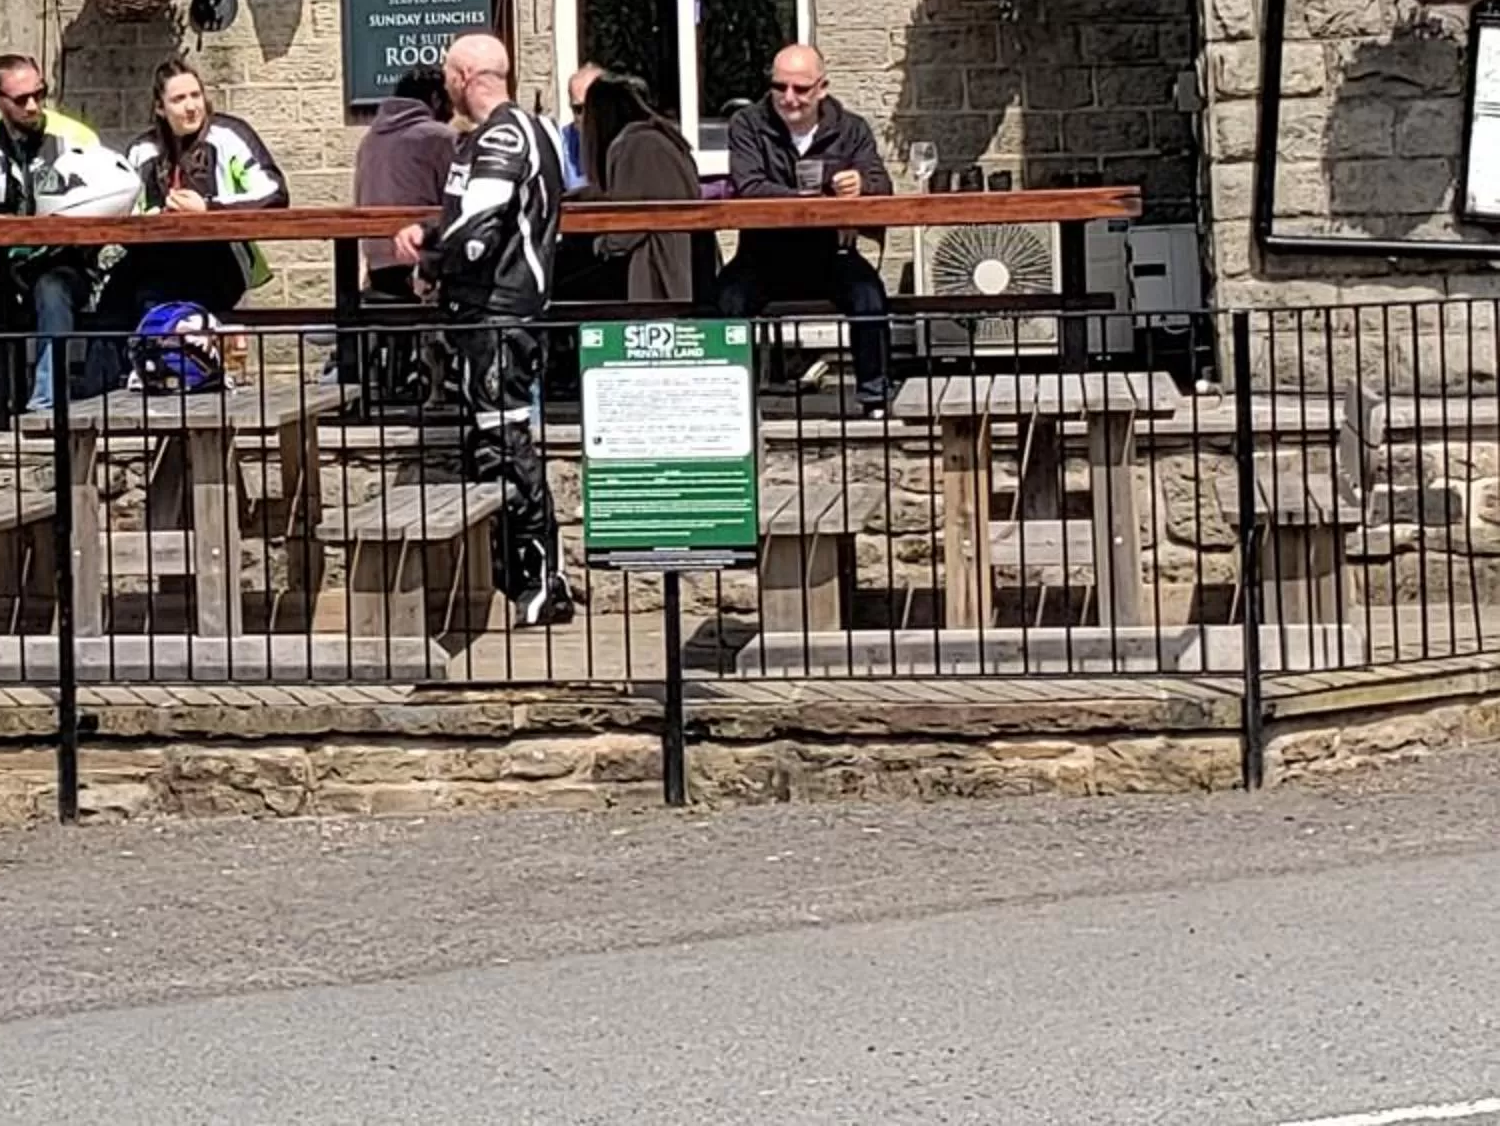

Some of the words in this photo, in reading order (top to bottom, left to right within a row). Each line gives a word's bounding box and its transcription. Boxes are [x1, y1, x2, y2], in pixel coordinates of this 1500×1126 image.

[369, 13, 421, 27] SUNDAY
[425, 10, 485, 25] LUNCHES
[399, 34, 416, 46] EN
[385, 46, 448, 66] ROO
[674, 347, 704, 358] LAND
